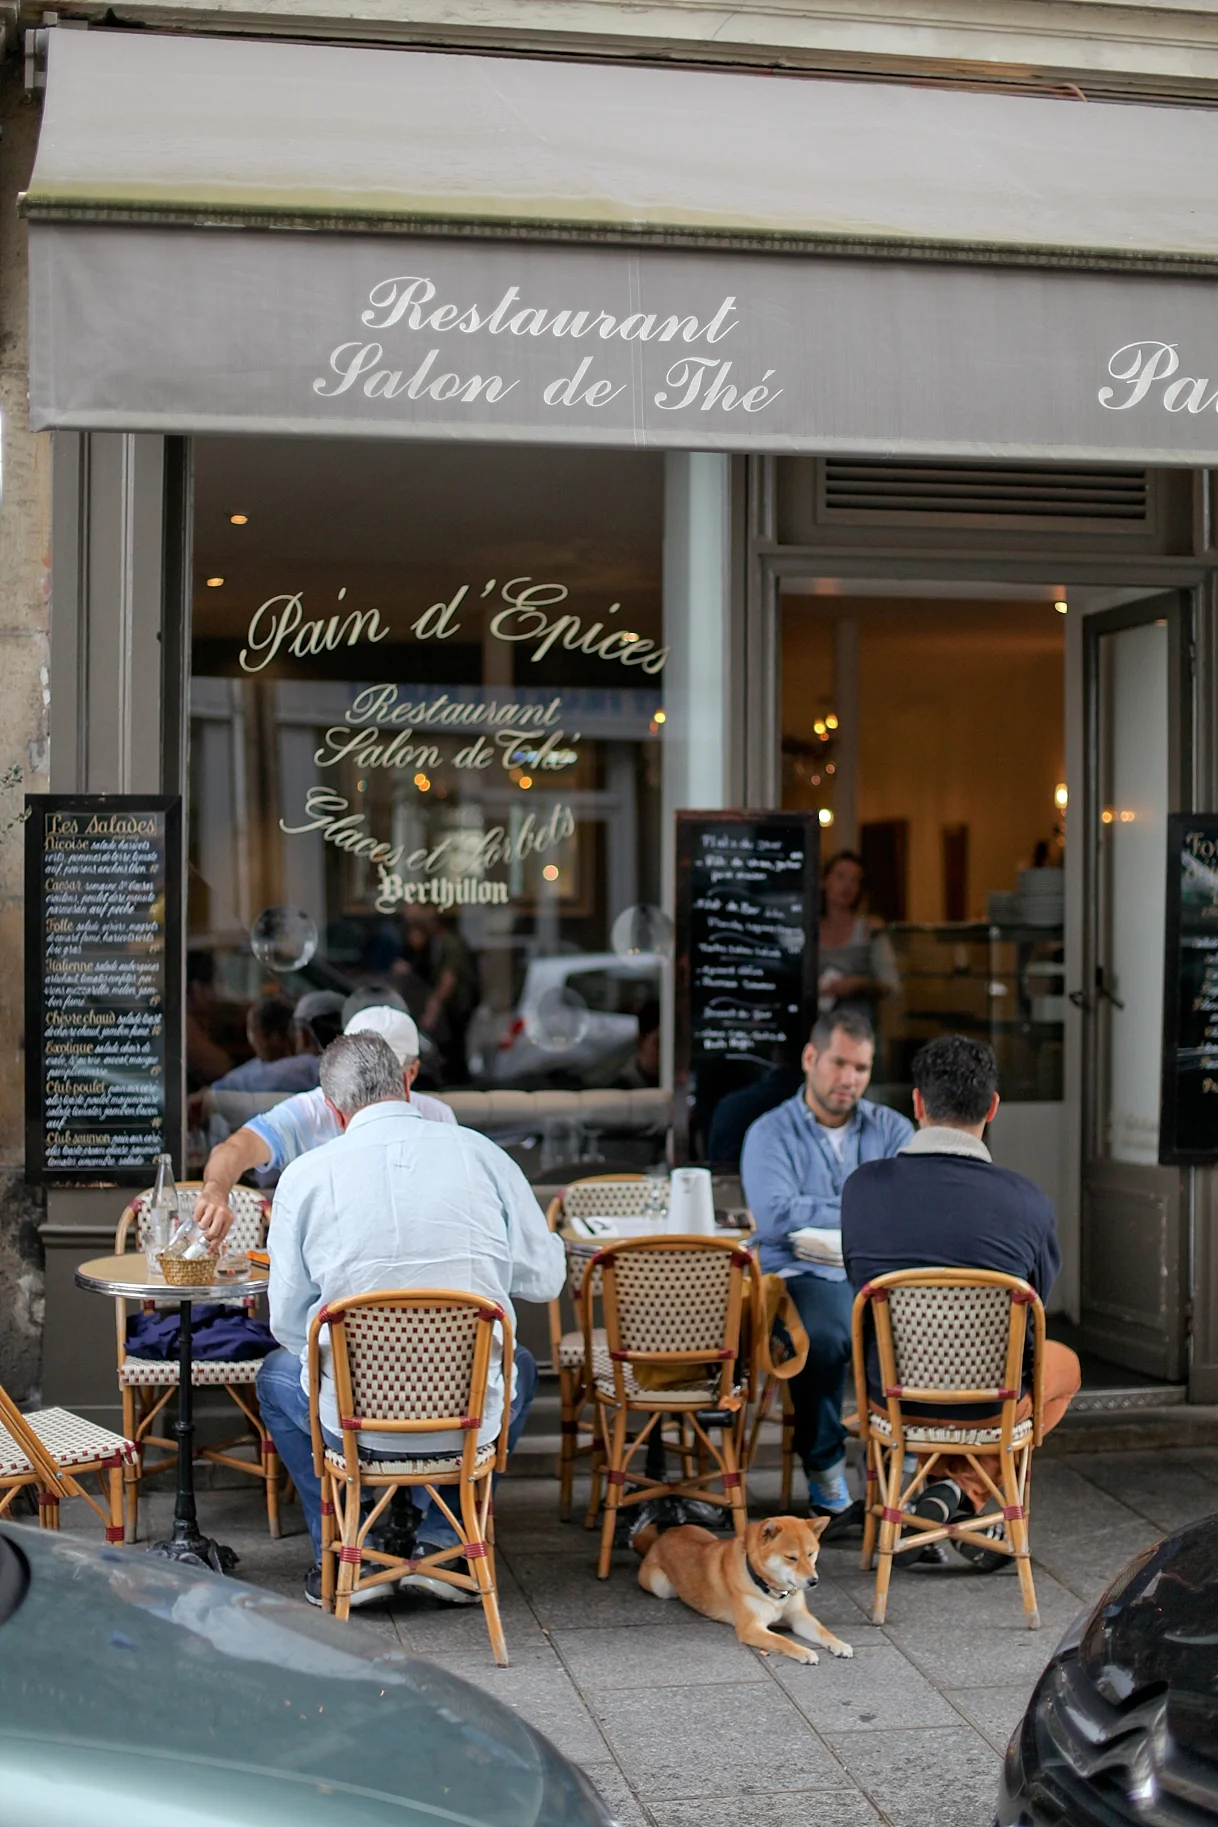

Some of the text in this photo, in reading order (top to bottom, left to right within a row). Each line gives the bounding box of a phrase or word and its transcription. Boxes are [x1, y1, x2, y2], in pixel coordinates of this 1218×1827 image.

[362, 276, 740, 343] Restaurant
[313, 342, 784, 412] Salon de Thé
[1098, 341, 1218, 414] Pa
[239, 587, 390, 673] Pain
[345, 684, 562, 726] Restaurant
[314, 726, 581, 771] Salon de Thé
[49, 814, 79, 835] Les
[280, 787, 405, 868] Glaces
[406, 838, 453, 872] et
[375, 865, 510, 914] Berthillon
[46, 917, 74, 933] Folle
[46, 958, 94, 973] Italienne
[45, 1040, 94, 1056] Exotique
[46, 1079, 73, 1095] Club
[73, 1079, 105, 1097] poulet
[46, 1130, 72, 1147] Club
